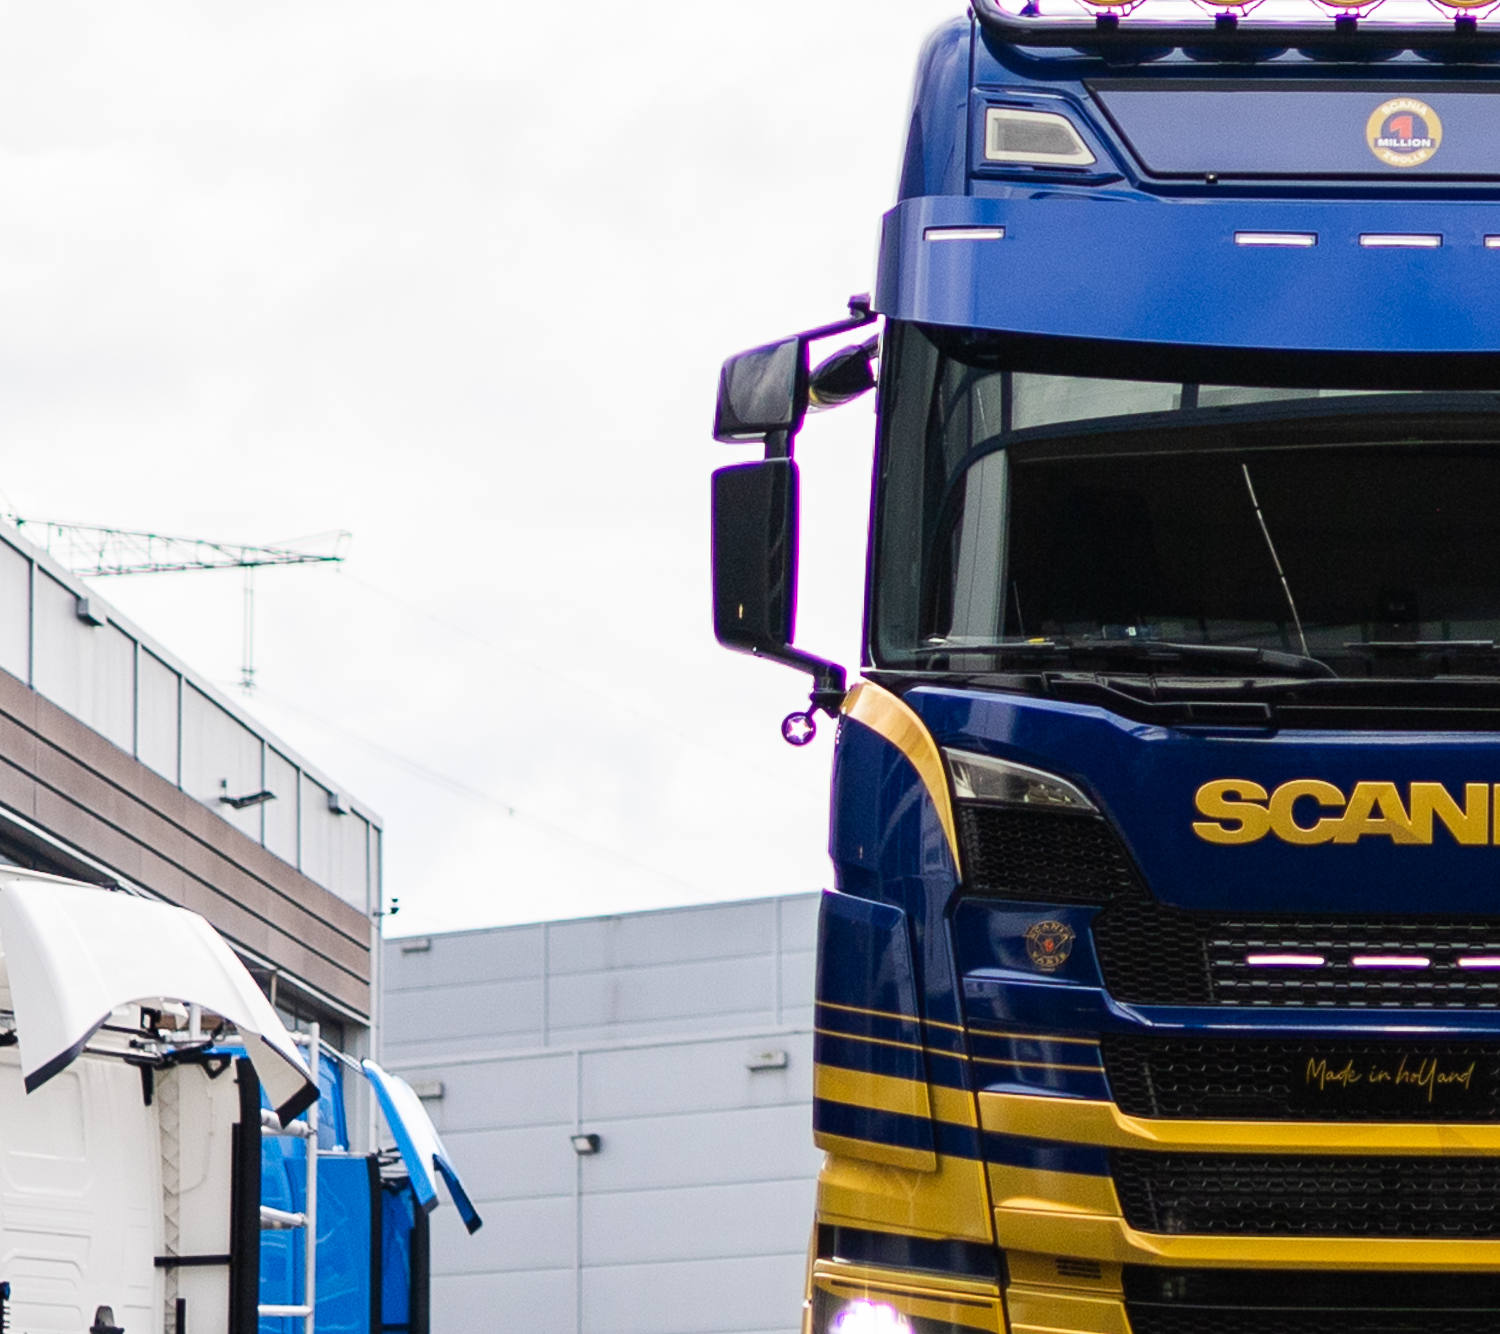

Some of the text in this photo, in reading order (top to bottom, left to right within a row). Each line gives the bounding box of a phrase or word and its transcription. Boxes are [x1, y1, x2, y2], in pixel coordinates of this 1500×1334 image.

[1382, 101, 1428, 116] SCANIA
[1389, 115, 1413, 139] 1
[1377, 138, 1432, 148] MILLION
[1306, 1056, 1363, 1091] Made
[1369, 1064, 1392, 1083] in
